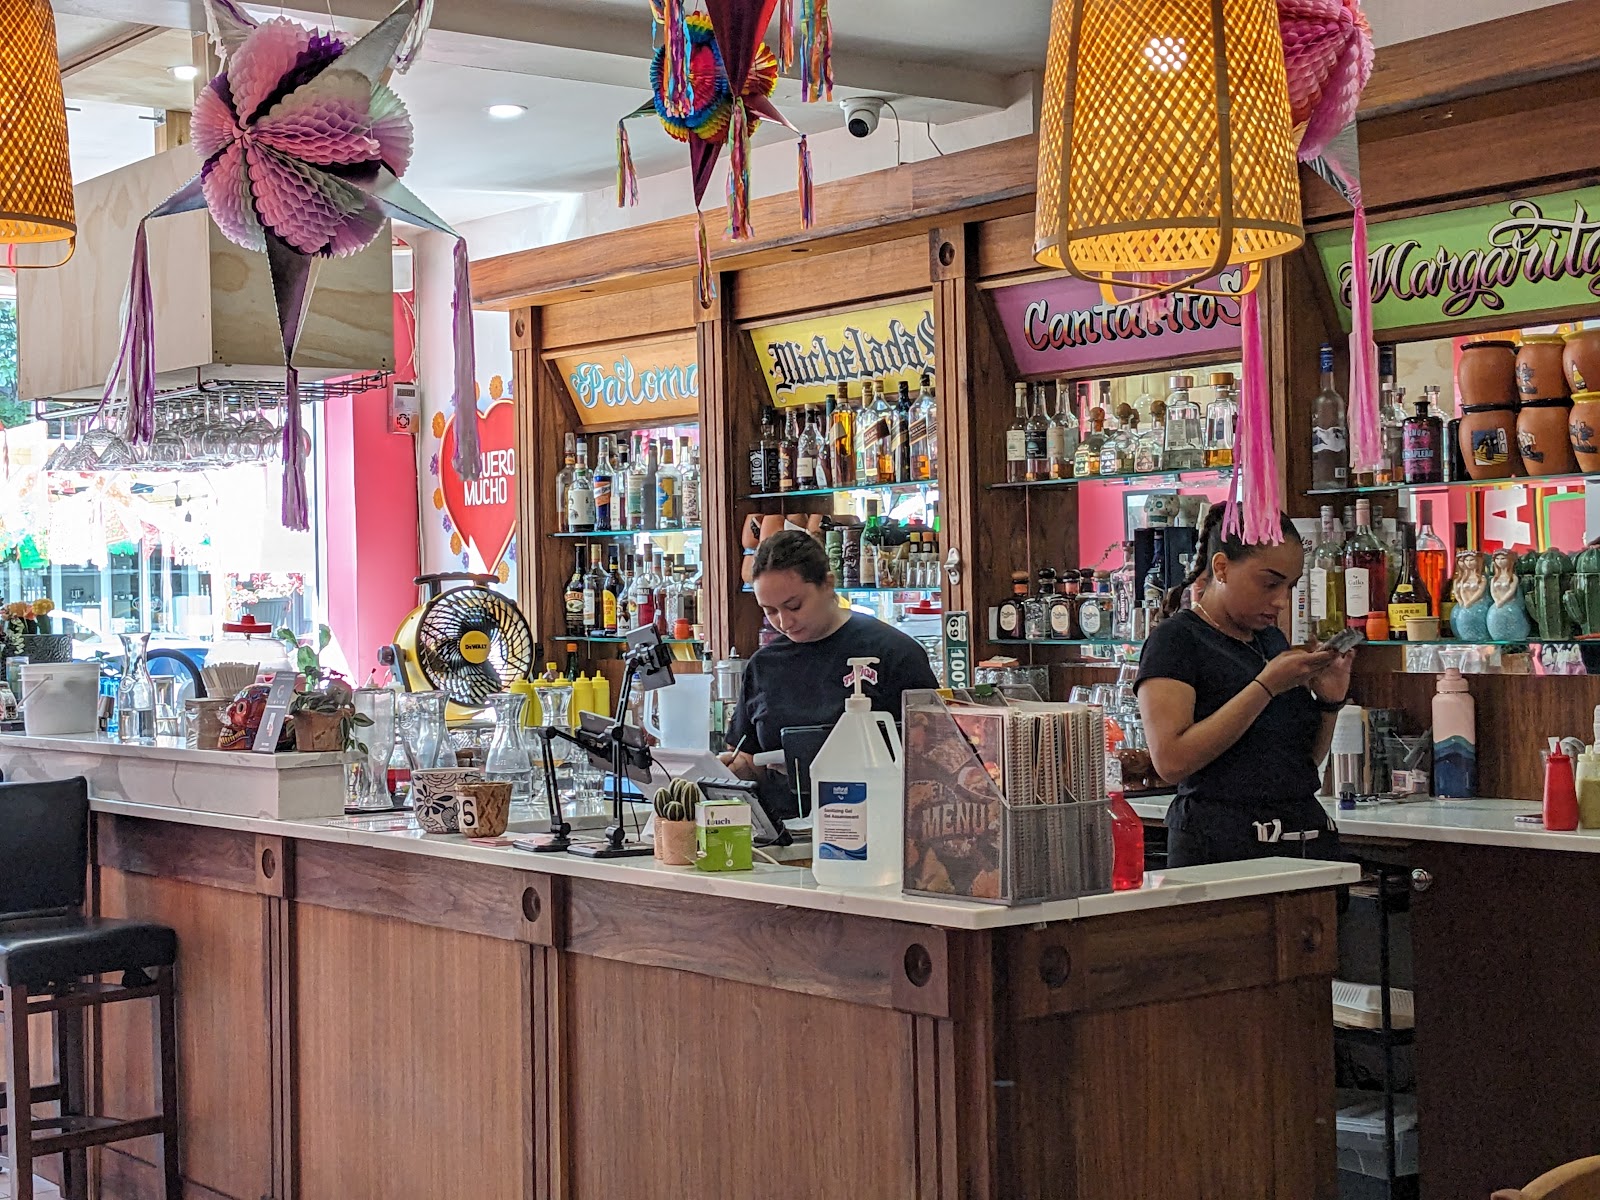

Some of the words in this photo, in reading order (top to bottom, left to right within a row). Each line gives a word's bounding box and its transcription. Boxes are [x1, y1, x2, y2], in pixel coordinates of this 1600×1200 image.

[479, 448, 515, 478] UERO
[464, 477, 507, 506] MUCHO
[950, 618, 959, 638] 69
[921, 801, 987, 838] MENU
